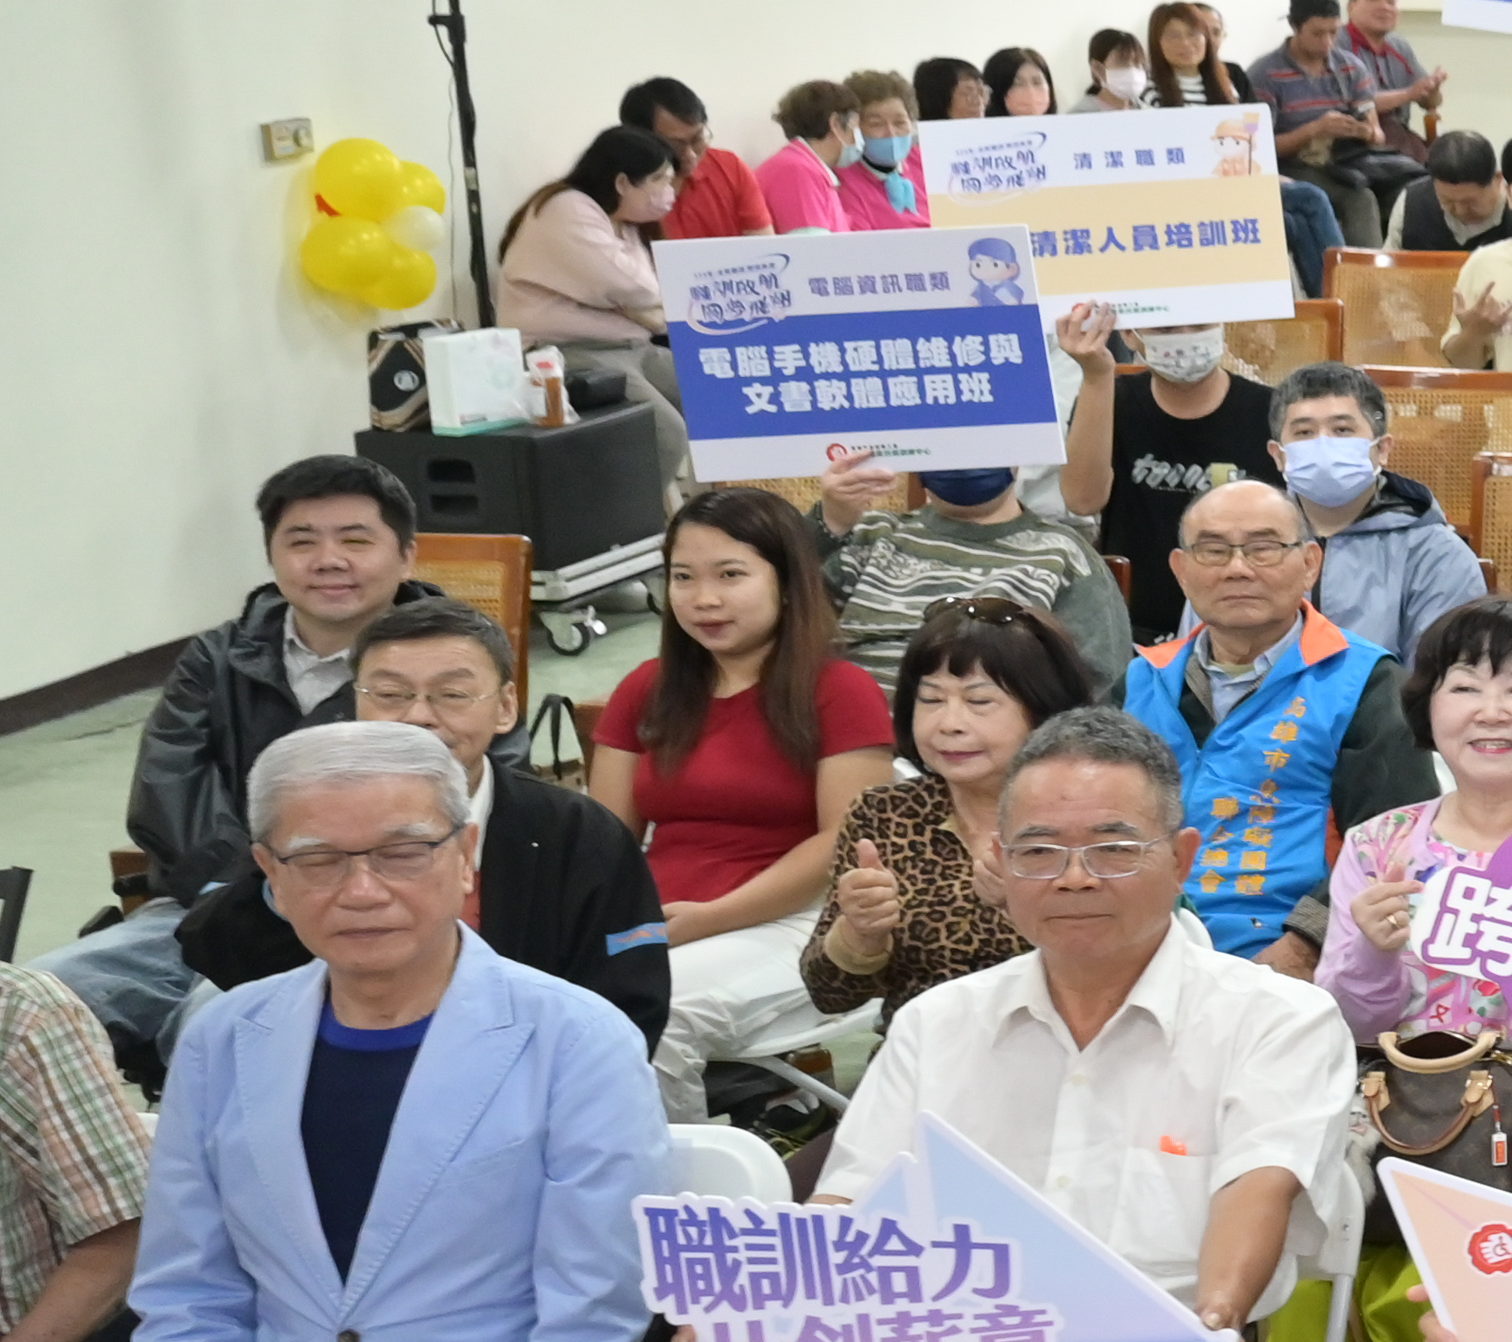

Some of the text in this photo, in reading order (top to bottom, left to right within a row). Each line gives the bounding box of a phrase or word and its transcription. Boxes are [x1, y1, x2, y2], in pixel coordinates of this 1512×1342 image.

[1073, 147, 1186, 170] 清潔職類
[1030, 218, 1261, 258] 清潔人員培訓班
[808, 271, 951, 298] 電腦資訊職類
[698, 333, 1024, 379] 電腦手機硬體維修與
[742, 370, 995, 415] 文書軟體應用班
[645, 1206, 1013, 1316] 職訓給力
